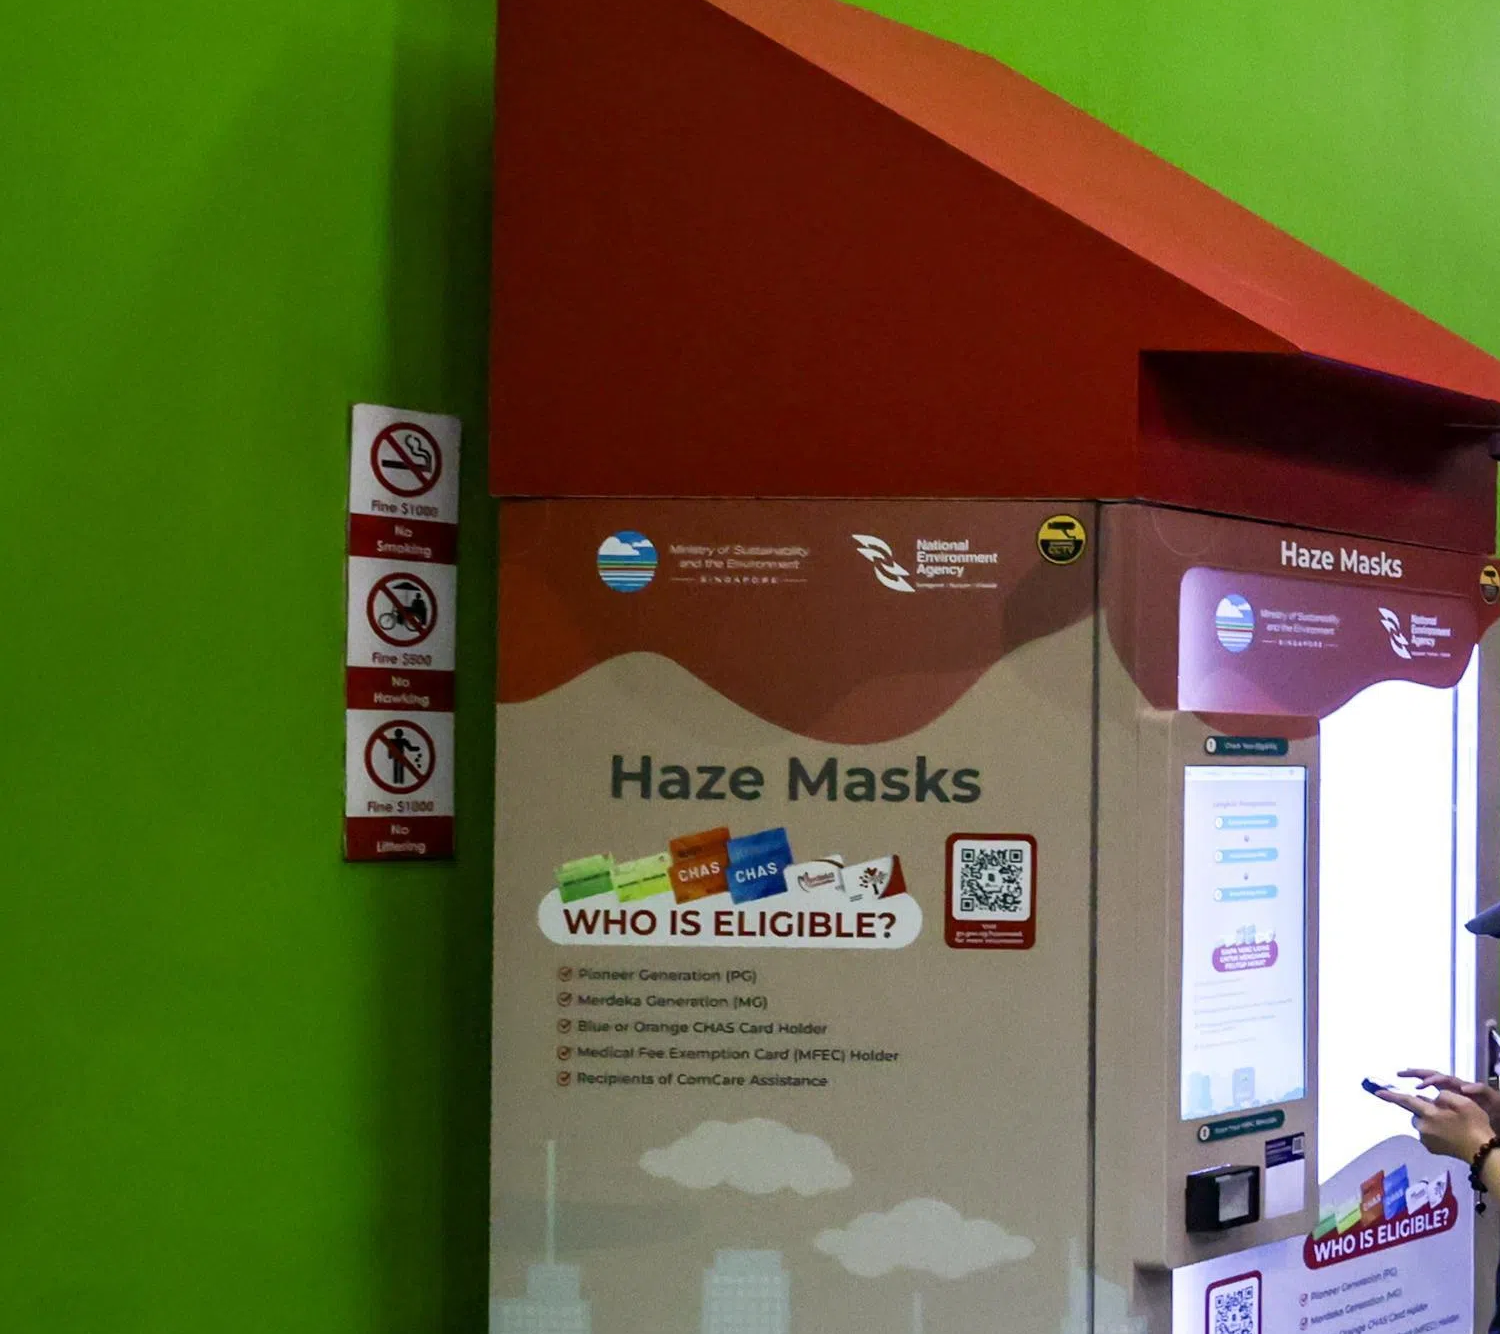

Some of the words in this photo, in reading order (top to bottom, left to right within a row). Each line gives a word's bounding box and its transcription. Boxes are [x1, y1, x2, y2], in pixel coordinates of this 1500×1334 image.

[371, 499, 399, 514] Fine
[394, 525, 414, 538] No
[376, 540, 433, 558] Smoking
[668, 544, 716, 557] Ministry
[915, 538, 970, 552] National
[915, 551, 999, 565] Environment
[1280, 539, 1334, 571] Haze
[1339, 546, 1403, 578] Masks
[915, 564, 965, 578] Agency
[371, 652, 398, 665] Fine
[391, 675, 411, 688] No
[373, 692, 430, 708] Hawking
[610, 754, 766, 803] Haze
[787, 755, 983, 805] Masks
[367, 800, 394, 813] Fine
[390, 824, 410, 836] No
[376, 840, 427, 854] Littering
[677, 861, 721, 883] CHAS
[734, 861, 779, 884] CHAS
[562, 907, 658, 936] WHO
[669, 908, 702, 936] IS
[713, 910, 898, 940] ELIGIBLE?
[578, 969, 635, 982] Pioneer
[638, 969, 722, 983] Generation
[726, 969, 758, 985] (PG)
[578, 994, 643, 1008] Merdeka
[646, 995, 729, 1009] Generation
[733, 995, 769, 1011] (MG)
[577, 1020, 610, 1034] Blue
[614, 1023, 631, 1034] or
[633, 1021, 689, 1037] Orange
[692, 1021, 735, 1035] CHAS
[739, 1021, 774, 1035] Card
[778, 1022, 829, 1036] Holder
[576, 1046, 634, 1060] Medical
[638, 1047, 667, 1060] Fee
[669, 1048, 751, 1063] Exemption
[753, 1048, 790, 1061] Card
[793, 1048, 847, 1065] (MFEC)
[850, 1049, 900, 1063] Holder
[576, 1072, 655, 1088] Recipients
[658, 1072, 675, 1086] of
[677, 1073, 746, 1087] ComCare
[749, 1074, 829, 1088] Assistance
[1313, 1233, 1356, 1263] WHO
[1359, 1227, 1375, 1250] IS
[1377, 1207, 1450, 1245] ELIGIBLE?
